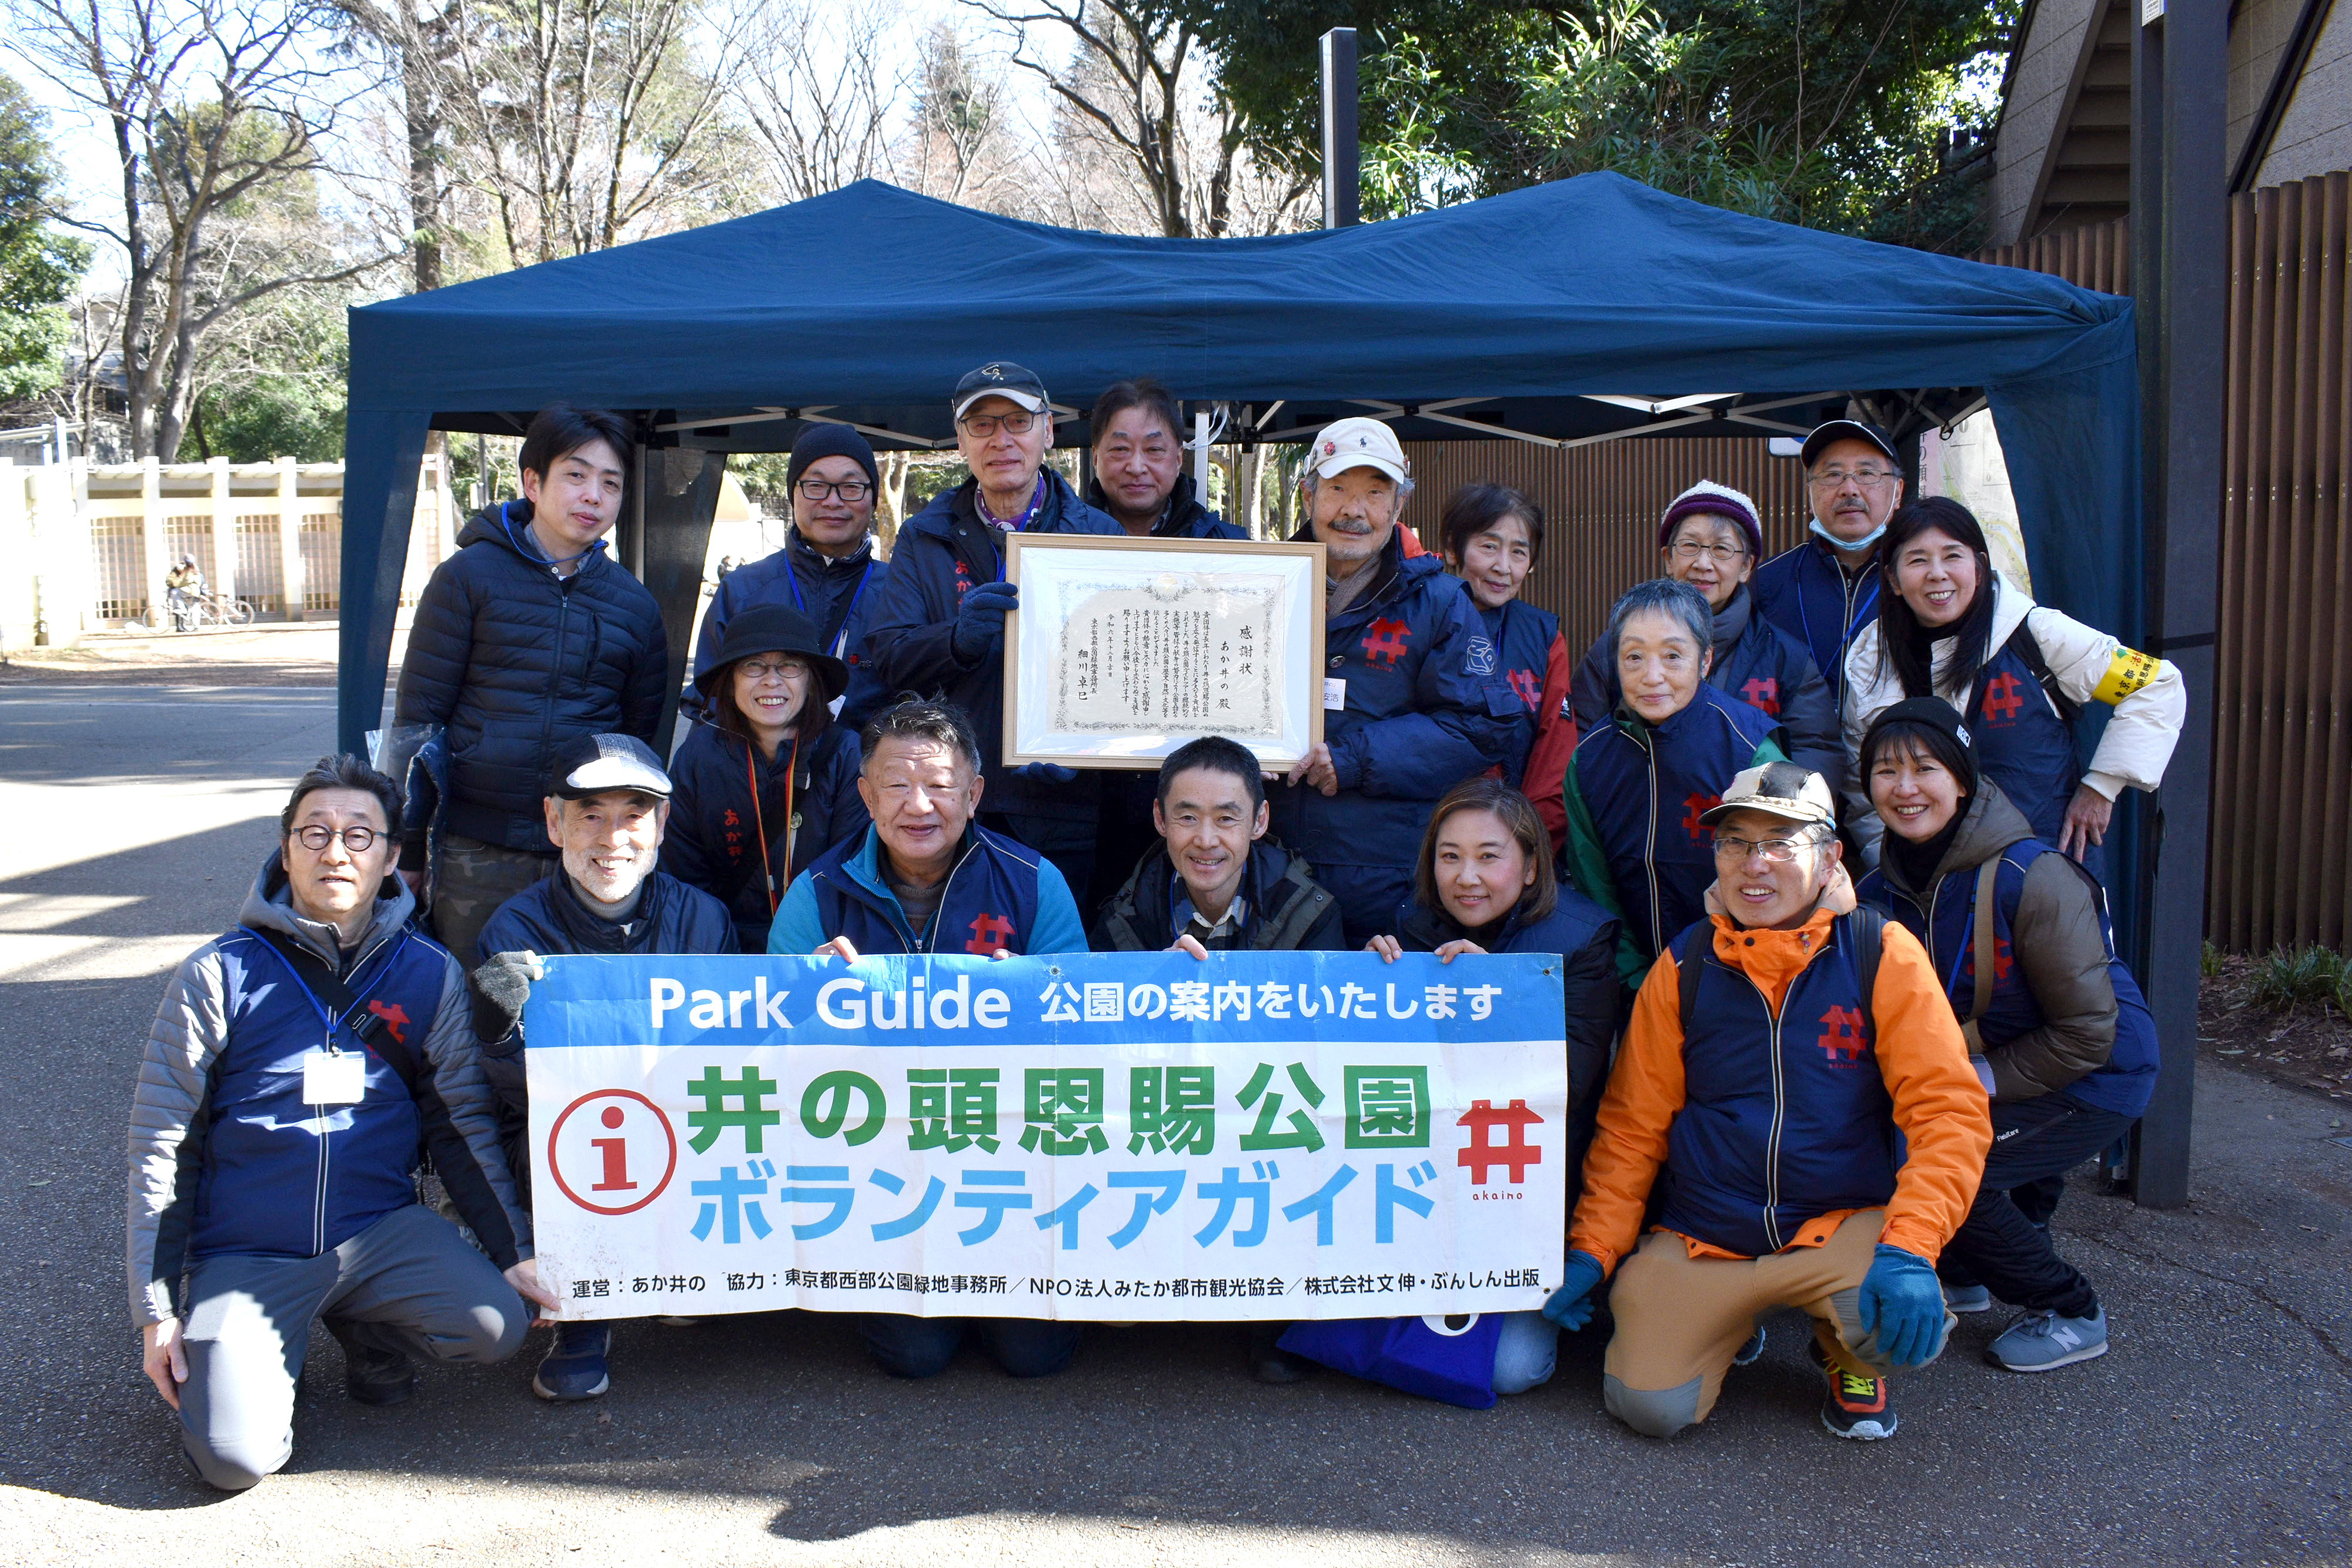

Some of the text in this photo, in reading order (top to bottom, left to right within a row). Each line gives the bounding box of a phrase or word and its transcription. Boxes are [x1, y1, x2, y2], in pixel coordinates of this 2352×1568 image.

[956, 560, 972, 605] あか
[1089, 617, 1098, 694] 東京都西部公園緑地事務所長
[1107, 613, 1115, 677] 令和六年十二月吉日
[1238, 626, 1253, 675] 感謝状
[2114, 668, 2136, 699] 東京都
[650, 976, 1502, 1029] Park Guide 公園の案内をいたします
[689, 1062, 1430, 1155] 井の頭恩賜公園
[1996, 1128, 2019, 1142] FieldCore
[690, 1159, 1438, 1250] ボランティアガイド
[1472, 1190, 1523, 1201] akaino
